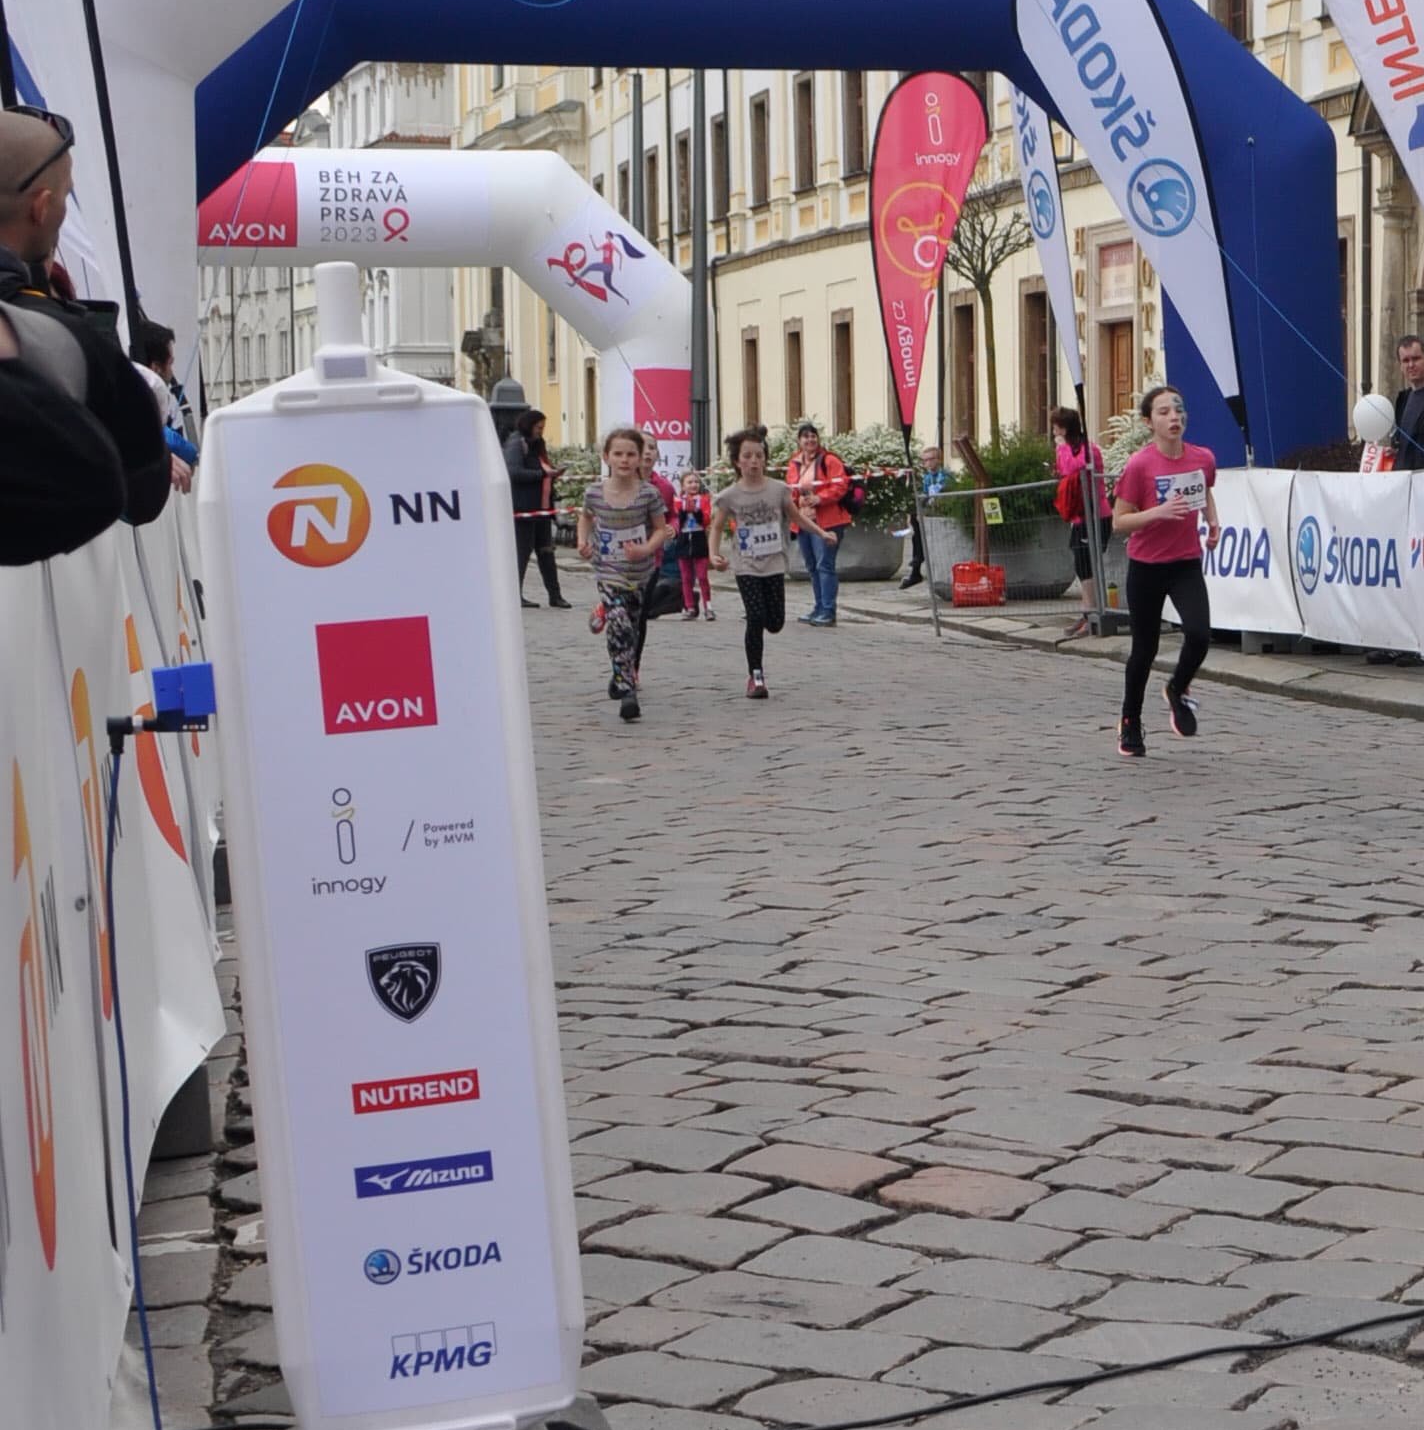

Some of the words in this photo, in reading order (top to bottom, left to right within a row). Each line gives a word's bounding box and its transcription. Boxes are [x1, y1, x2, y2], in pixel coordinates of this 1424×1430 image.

[915, 152, 961, 165] innogy
[319, 170, 364, 184] BĚH
[372, 170, 398, 184] ZA
[319, 185, 408, 203] ZDRAVÁ
[320, 207, 375, 223] PRSA
[208, 223, 286, 243] AVON
[320, 227, 377, 242] 2023
[892, 300, 916, 388] innogy.cz
[390, 489, 461, 525] NN
[1324, 526, 1402, 588] ŠKODA
[335, 697, 424, 725] AVON
[423, 819, 474, 833] Powered
[424, 835, 439, 849] by
[443, 831, 474, 845] MVM
[311, 875, 387, 895] innogy
[372, 948, 433, 962] PEUGEOT
[359, 1076, 474, 1107] NUTREND
[407, 1241, 502, 1276] ŠKODA
[389, 1340, 494, 1379] KPMG
